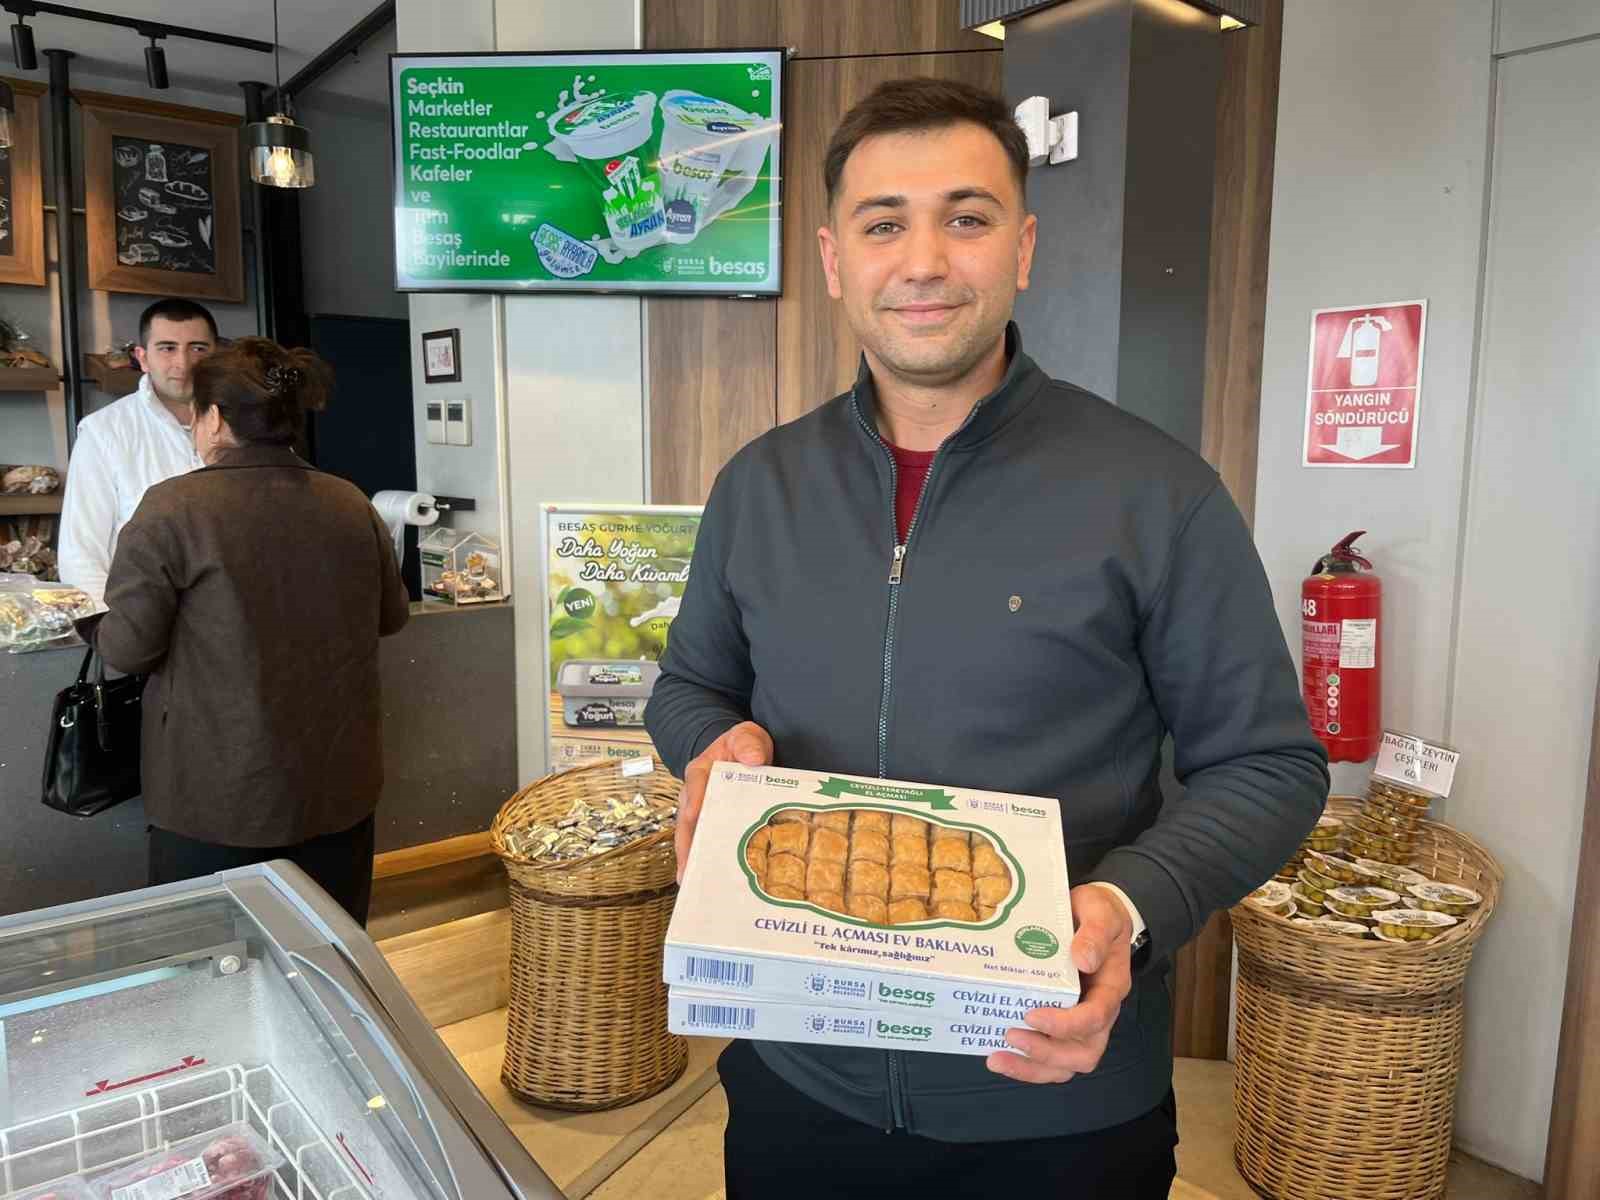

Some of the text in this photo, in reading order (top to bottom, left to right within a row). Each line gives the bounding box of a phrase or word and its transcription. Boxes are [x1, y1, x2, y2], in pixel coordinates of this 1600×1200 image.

[407, 76, 465, 98] Seçkin
[408, 99, 493, 117] Marketler
[408, 120, 529, 139] Restaurantlar
[409, 142, 523, 160] Fast-Foodlar
[410, 164, 473, 182] Kafeler
[411, 190, 432, 203] ve
[412, 250, 511, 270] Bayilerinde
[709, 255, 766, 278] besaş
[1334, 392, 1392, 407] YANGIN
[1314, 408, 1410, 426] SÖNDÜRÜCÜ
[558, 522, 596, 534] BESAŞ
[557, 537, 659, 563] Daha Yoğun
[580, 560, 626, 582] Daha
[754, 917, 996, 958] CEVİZLİ EL AÇMASI EV BAKLAVASI
[833, 979, 866, 989] BURSA
[878, 982, 936, 1005] besaş
[952, 989, 996, 1004] CEVİZLİ
[999, 995, 1013, 1007] EL
[964, 1004, 1025, 1021] EV BAKLAV
[833, 1018, 866, 1027] BURSA
[876, 1019, 933, 1039] besaş
[950, 1023, 992, 1036] CEVİZLİ
[960, 1036, 976, 1047] EV
